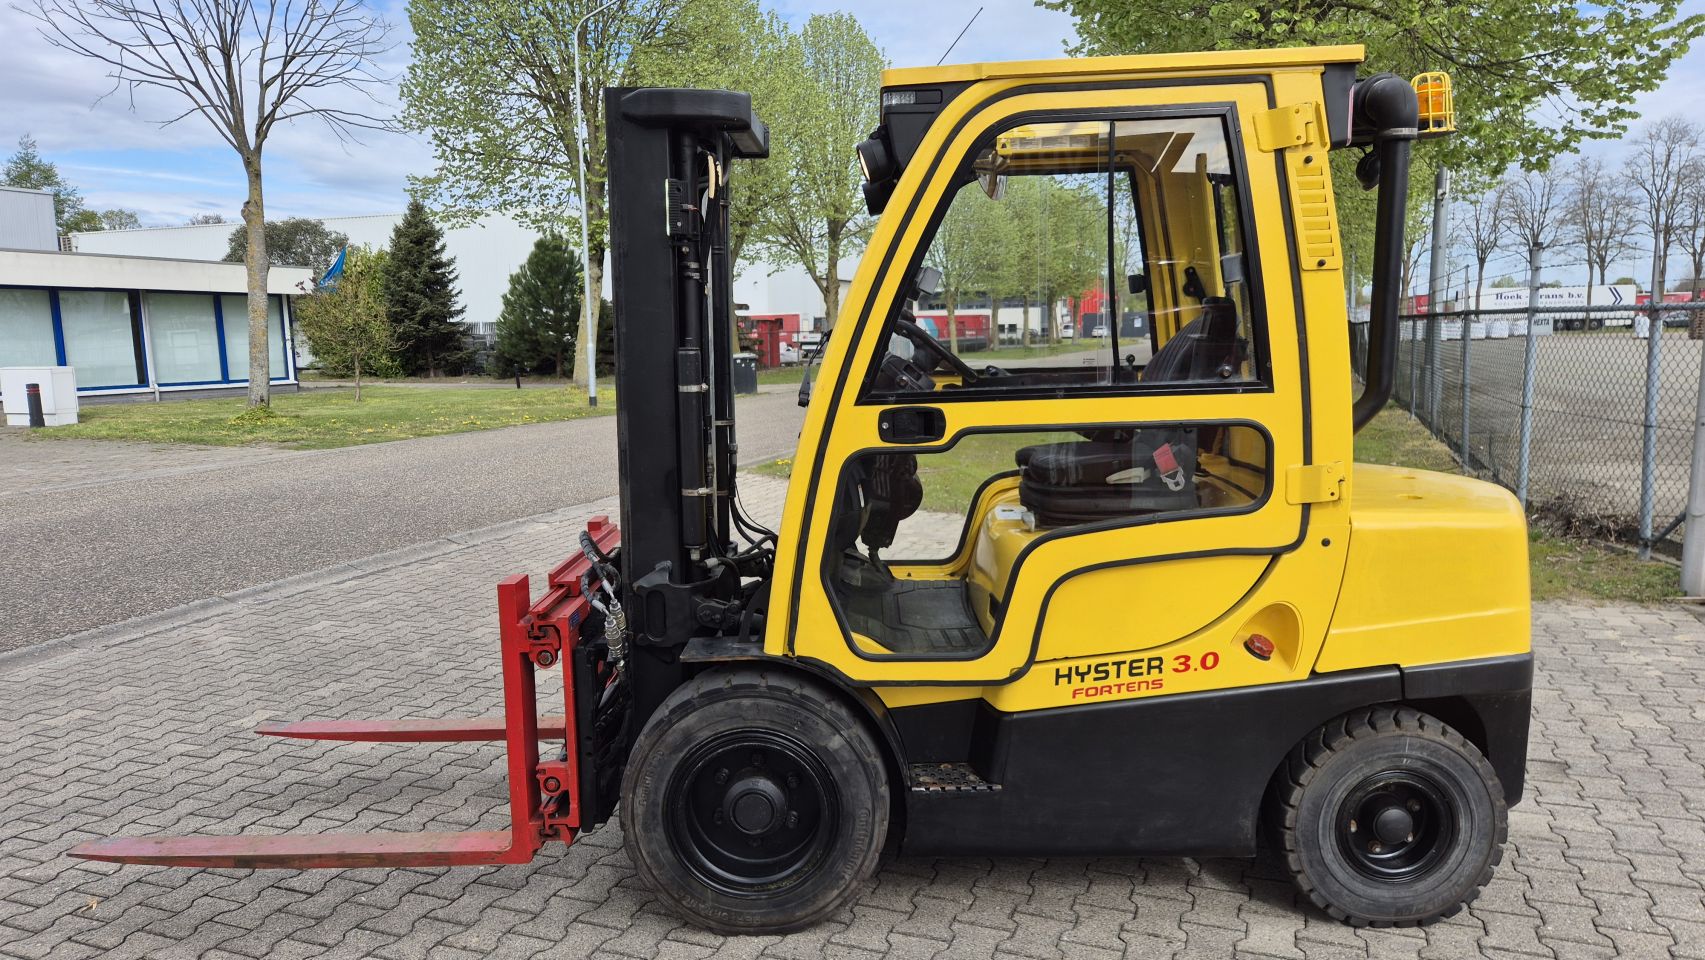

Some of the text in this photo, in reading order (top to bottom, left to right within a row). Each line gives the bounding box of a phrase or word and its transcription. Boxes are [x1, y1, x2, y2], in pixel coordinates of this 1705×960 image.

[1495, 292, 1522, 300] Hoek
[1539, 292, 1564, 300] rans
[1055, 651, 1220, 686] HYSTER 3.0
[1072, 678, 1164, 699] FORTENS
